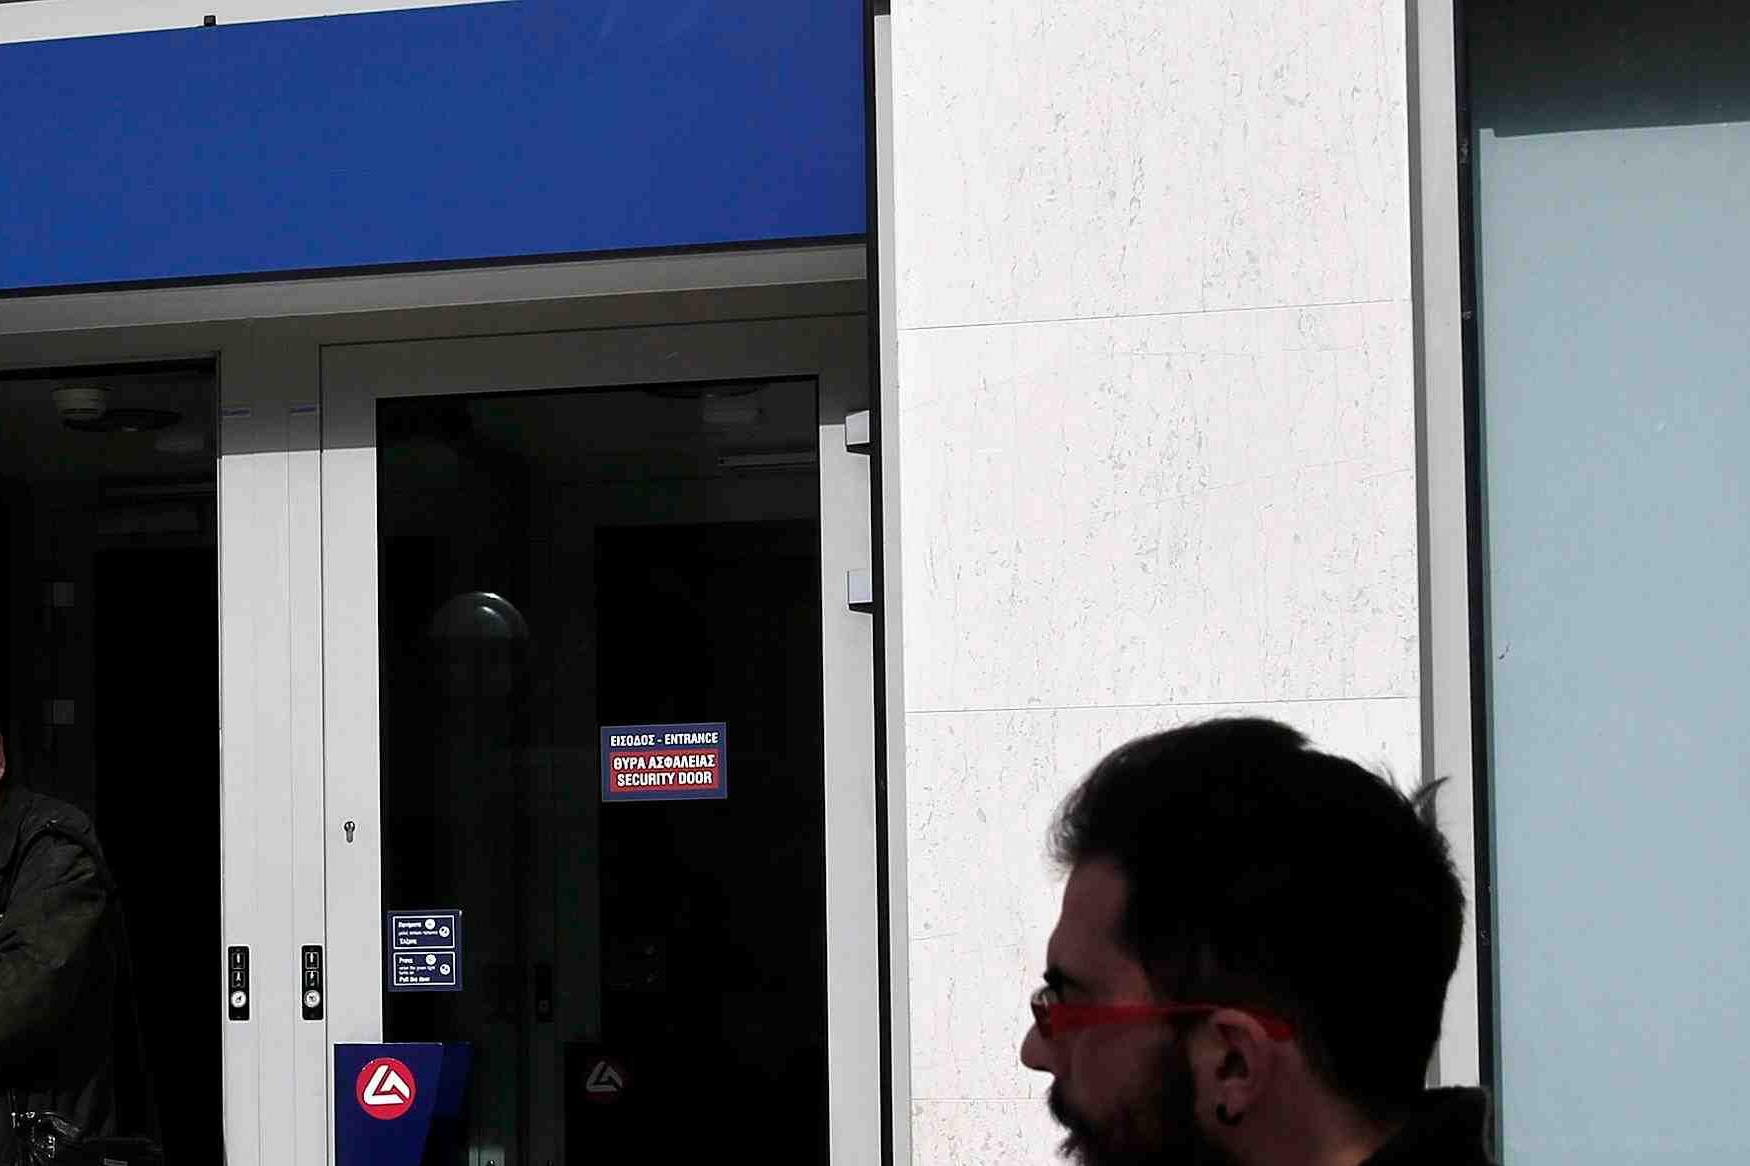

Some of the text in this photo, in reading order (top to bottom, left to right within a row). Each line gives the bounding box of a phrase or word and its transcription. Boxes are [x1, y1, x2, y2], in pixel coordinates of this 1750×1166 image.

[610, 734, 655, 747] ΕΙΣΟΔΟΣ
[664, 732, 719, 745] ENTRANCE
[613, 754, 716, 770] ΘΥΡΑ ΑΣΦΑΛΕΙΑΣ
[617, 771, 713, 787] SECURITY DOOR
